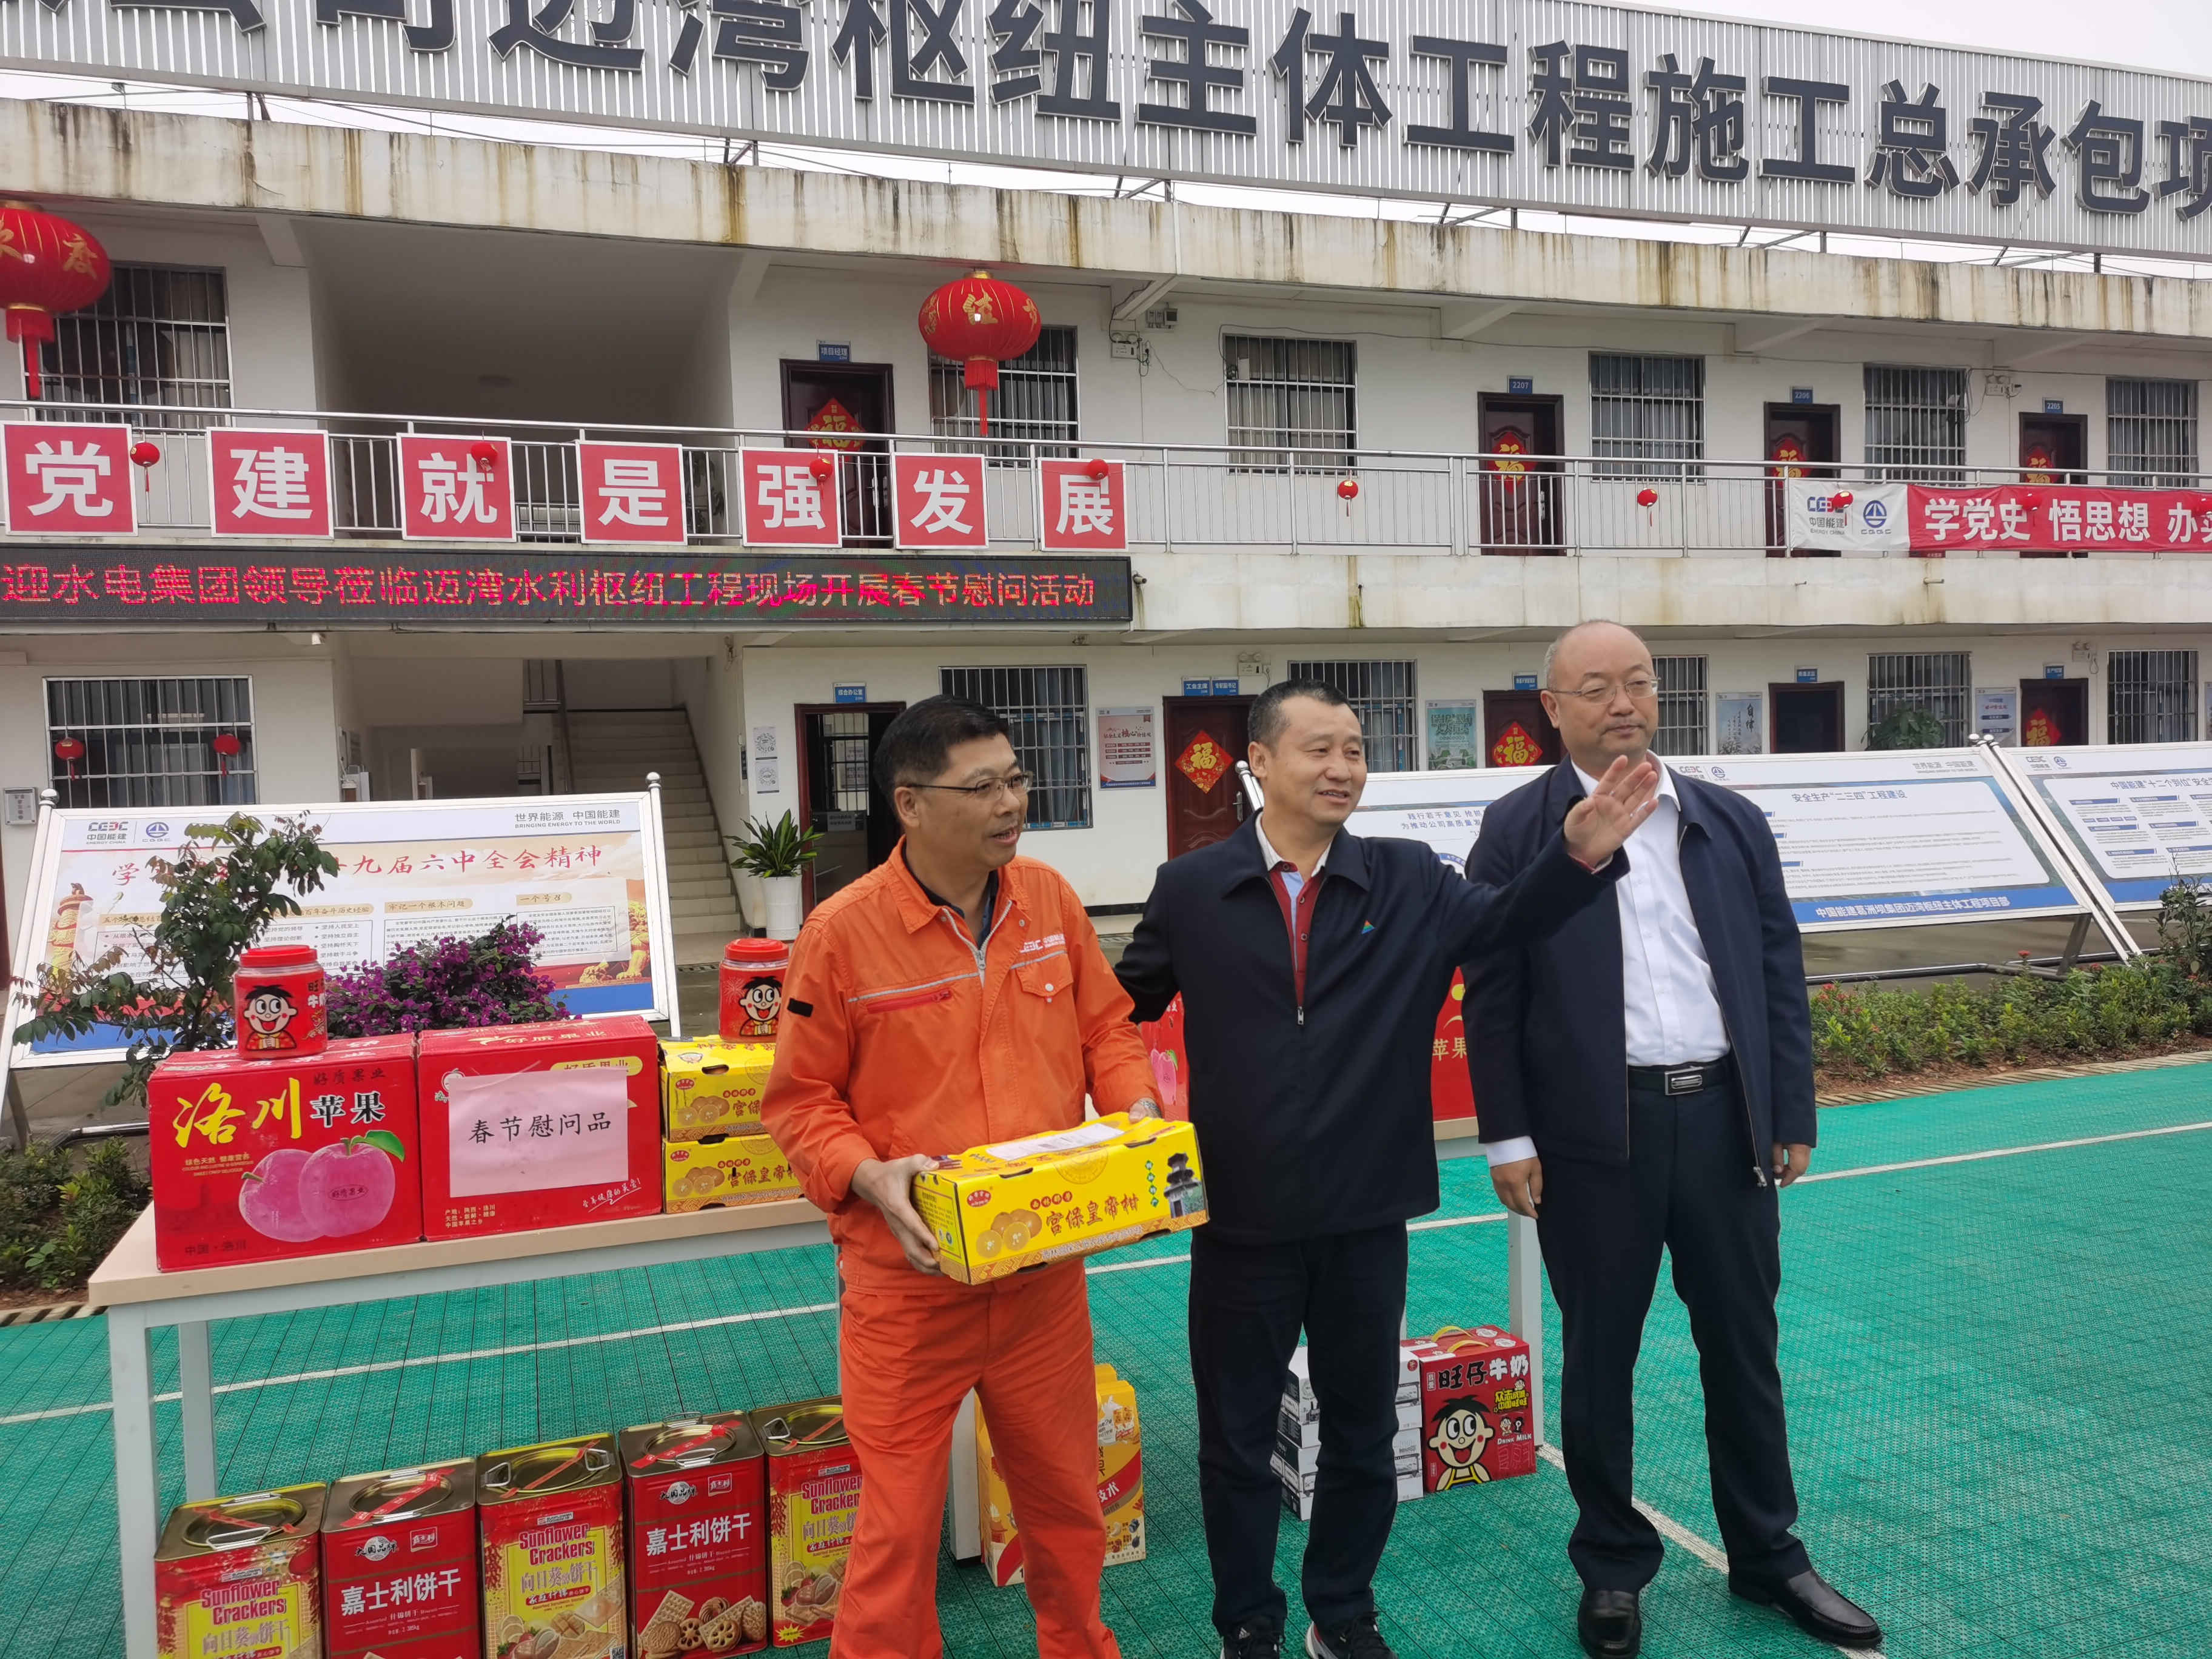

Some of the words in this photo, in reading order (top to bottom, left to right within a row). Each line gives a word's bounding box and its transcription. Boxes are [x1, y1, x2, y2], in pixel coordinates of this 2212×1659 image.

[109, 0, 2212, 222] 湾枢纽主体工程施工总承包项
[820, 346, 849, 357] 项目经理
[1809, 517, 1844, 529] 中国能建
[1925, 498, 2031, 541] 学党史
[2048, 498, 2151, 542] 悟思想
[2, 563, 1094, 607] 迎水电集团领导莅临迈湾水利枢纽工程现场开展春节慰问活动
[1746, 703, 1755, 732] 自律
[2026, 719, 2051, 746] 福
[1190, 742, 1217, 769] 福
[1503, 736, 1529, 764] 福
[2110, 777, 2212, 789] 中国能建“十二个到位”安全
[515, 811, 565, 822] 世界能源
[572, 809, 620, 820] 中国能建
[1407, 809, 1461, 820] 践行若干意见
[389, 900, 465, 910] 牢记一个根本问题
[520, 894, 561, 903] 一个号召
[1432, 1037, 1467, 1061] 苹果
[313, 1068, 386, 1086] 好质果业
[173, 1077, 302, 1148] 洛川
[310, 1091, 387, 1128] 苹果
[468, 1111, 612, 1144] 春节慰问品
[185, 1155, 216, 1166] 绿色天然
[1438, 1354, 1529, 1389] 旺仔牛奶
[802, 1475, 862, 1500] Sunflower
[811, 1492, 860, 1515] Cracker
[519, 1523, 590, 1550] Sunflower
[646, 1512, 752, 1557] 嘉士利饼干
[355, 1540, 398, 1557] 大国品牌
[529, 1541, 595, 1566] Crackers
[201, 1580, 281, 1608] Sunflower
[341, 1568, 461, 1616] 嘉士利饼干
[213, 1598, 287, 1625] Crackers
